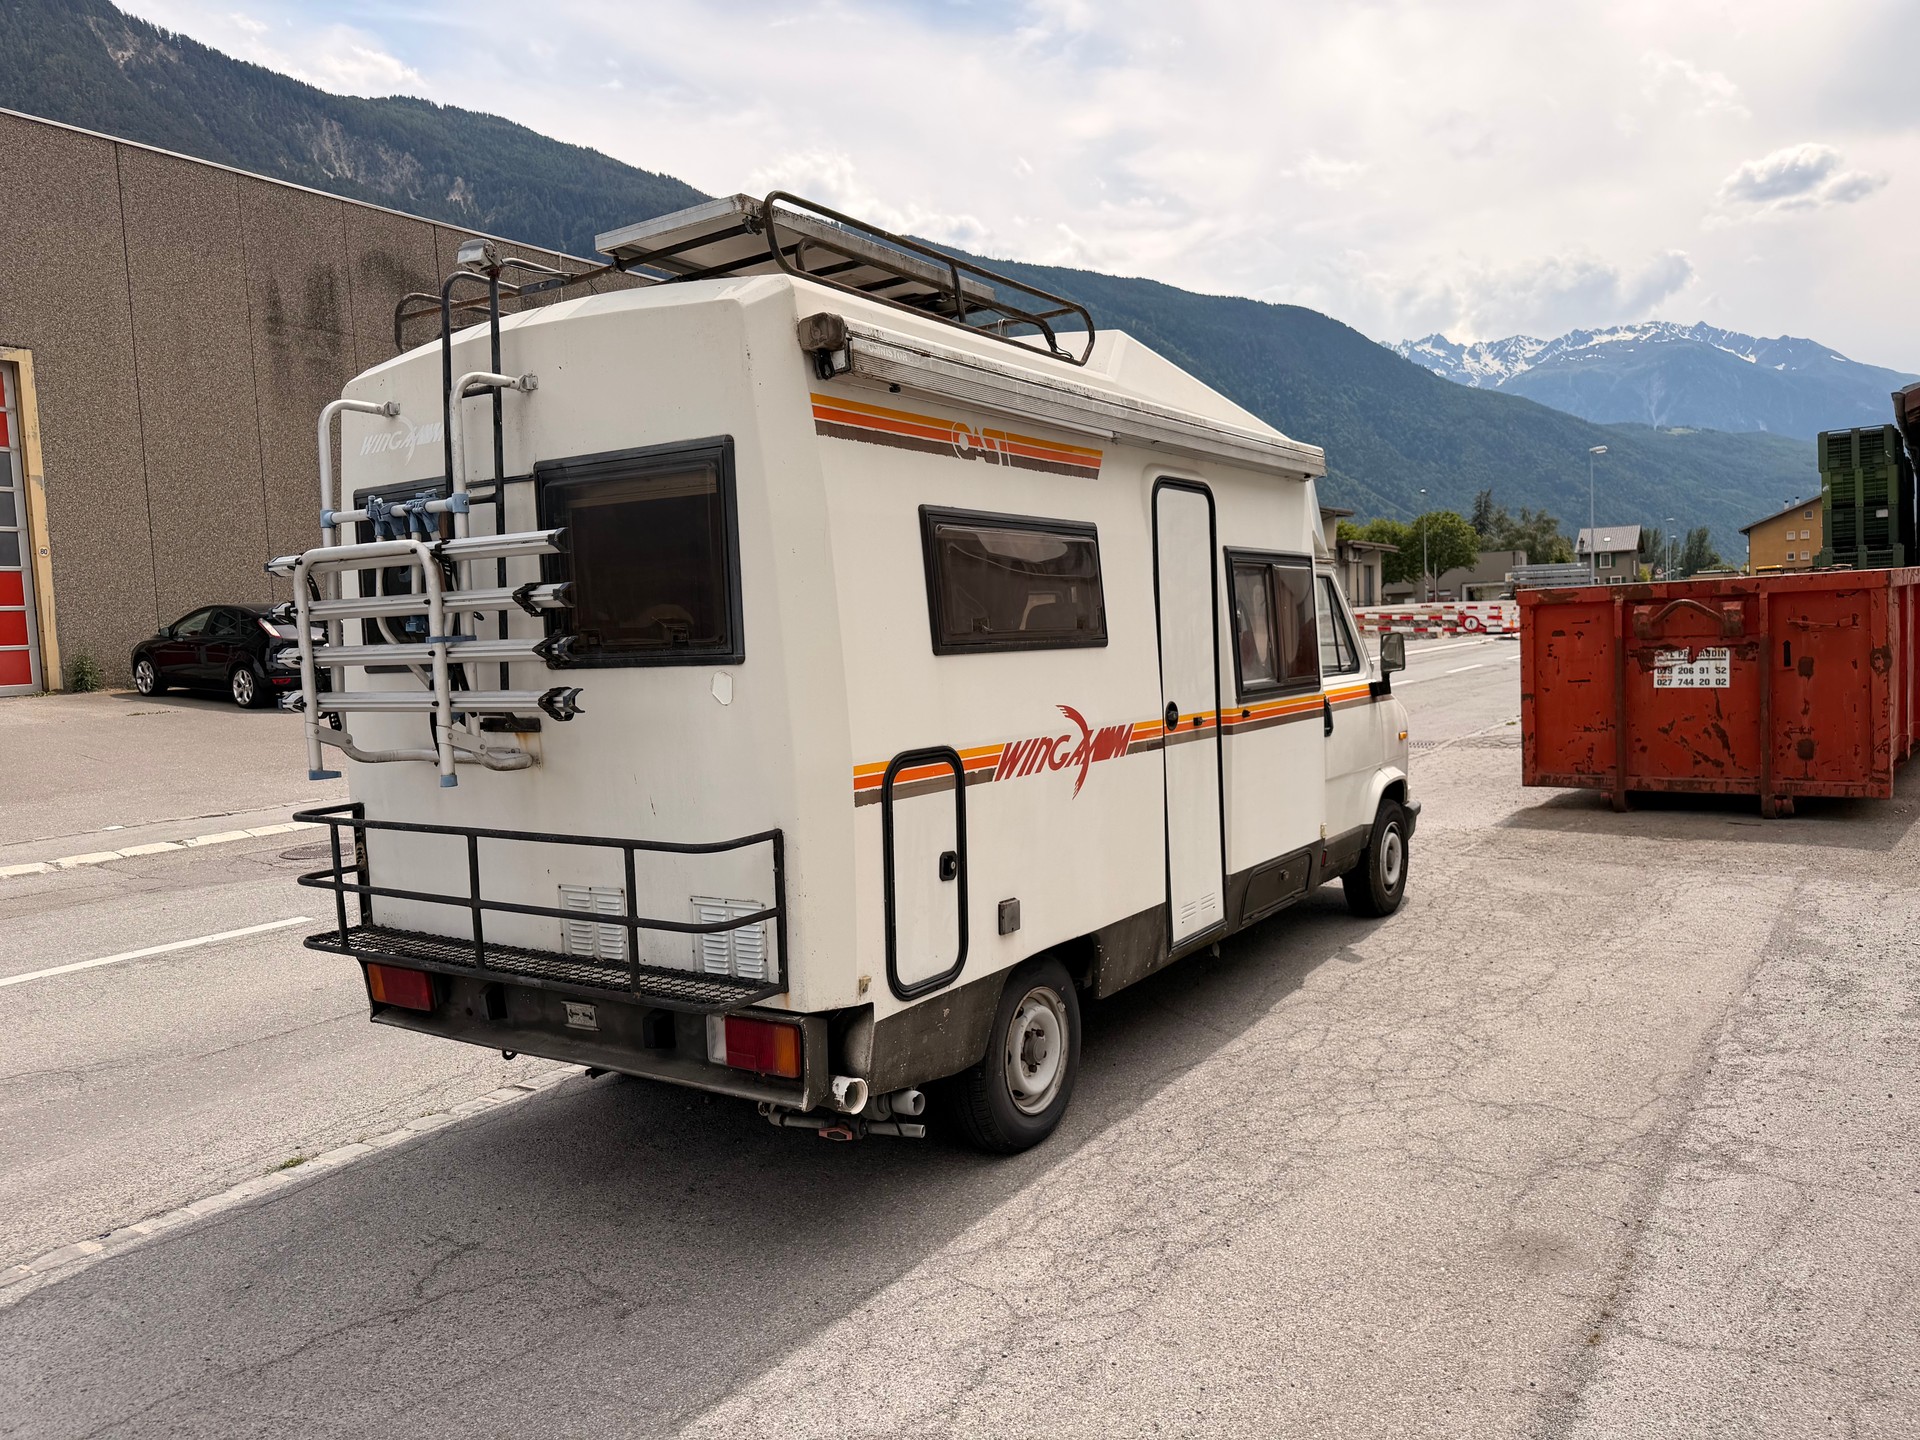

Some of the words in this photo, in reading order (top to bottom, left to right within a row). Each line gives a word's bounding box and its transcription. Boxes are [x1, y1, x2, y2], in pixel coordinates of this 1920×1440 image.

[1678, 667, 1694, 675] 206
[1699, 667, 1709, 675] 91
[1716, 667, 1727, 675] 52
[1657, 678, 1673, 686] 027
[1678, 678, 1694, 686] 744
[1699, 678, 1710, 686] 20
[1716, 678, 1727, 686] 02
